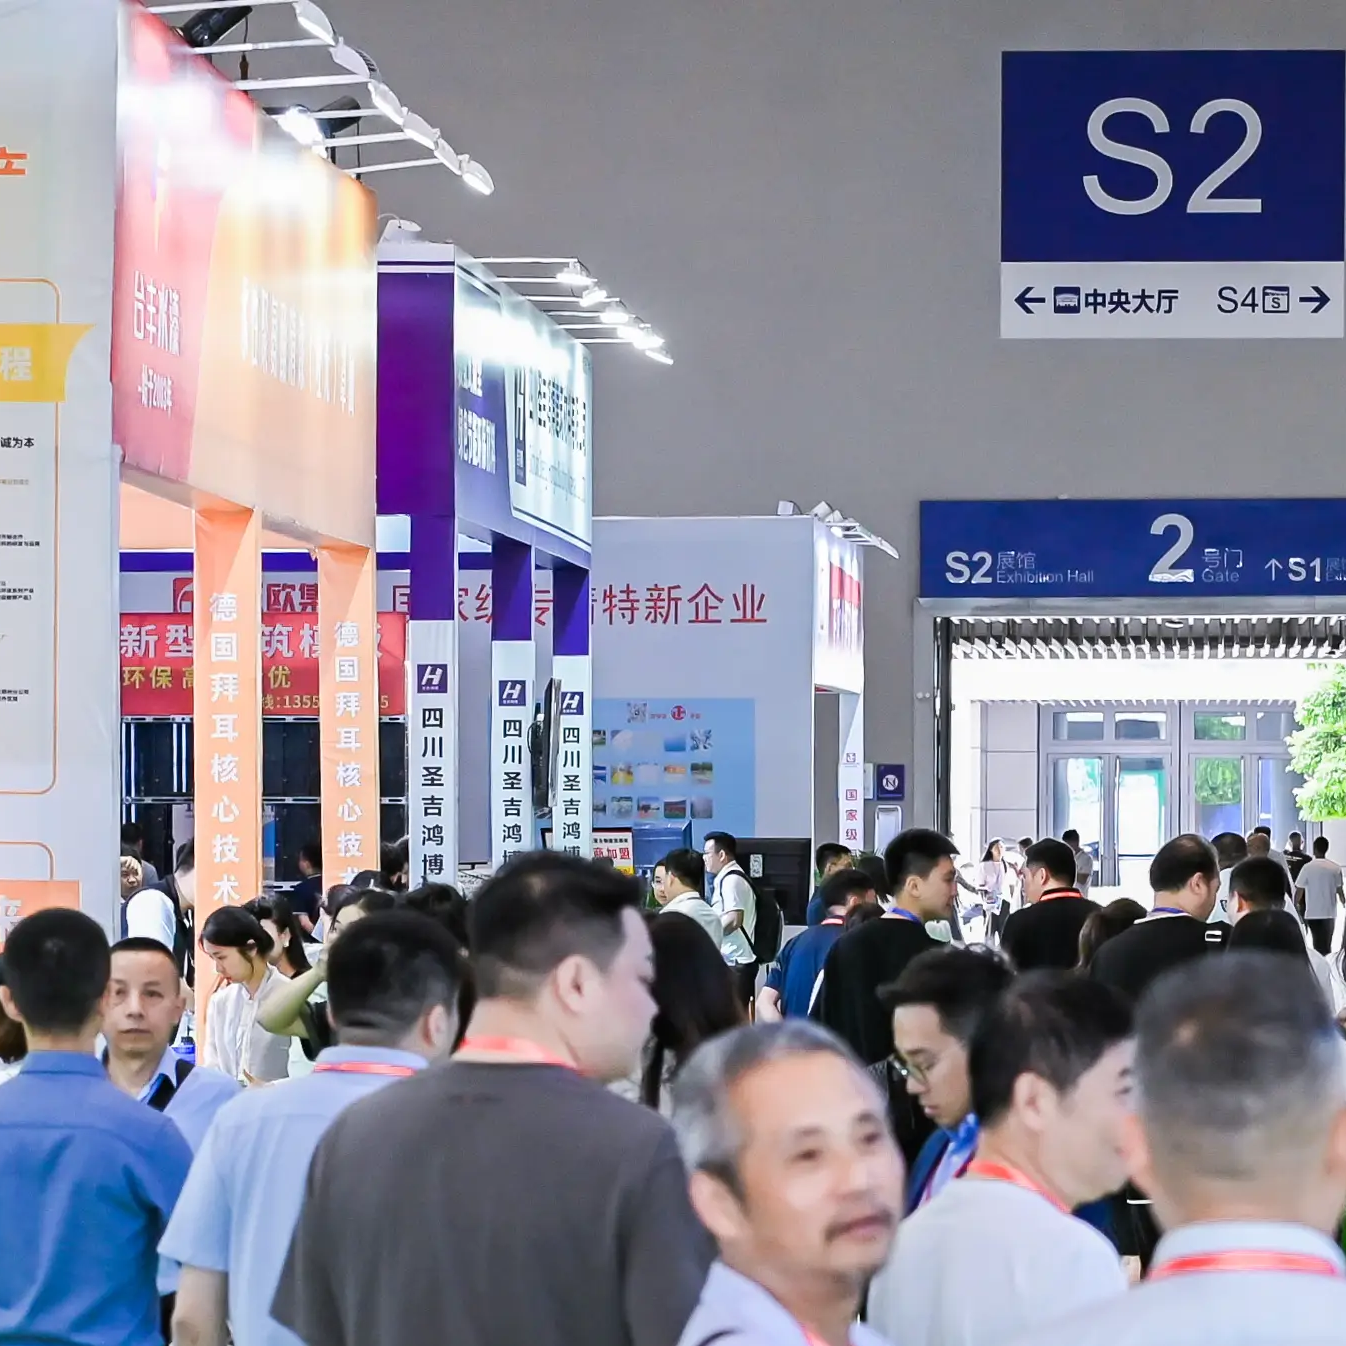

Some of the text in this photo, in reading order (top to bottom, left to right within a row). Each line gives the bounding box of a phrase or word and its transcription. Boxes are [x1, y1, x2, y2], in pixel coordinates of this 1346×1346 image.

[1083, 97, 1263, 215] S2
[1084, 288, 1179, 314] 中央大厅
[1216, 286, 1259, 314] S4
[996, 551, 1037, 569] 展馆
[1148, 512, 1195, 584] 2
[1202, 548, 1244, 569] 号门
[945, 551, 992, 584] S2
[996, 569, 1094, 584] Exhibition Hall
[1202, 569, 1240, 584] Gate
[1287, 557, 1322, 582] S1
[121, 665, 172, 690] 环保
[208, 591, 241, 905] 德国拜耳核心技术
[421, 707, 444, 876] 四川圣吉鸿博
